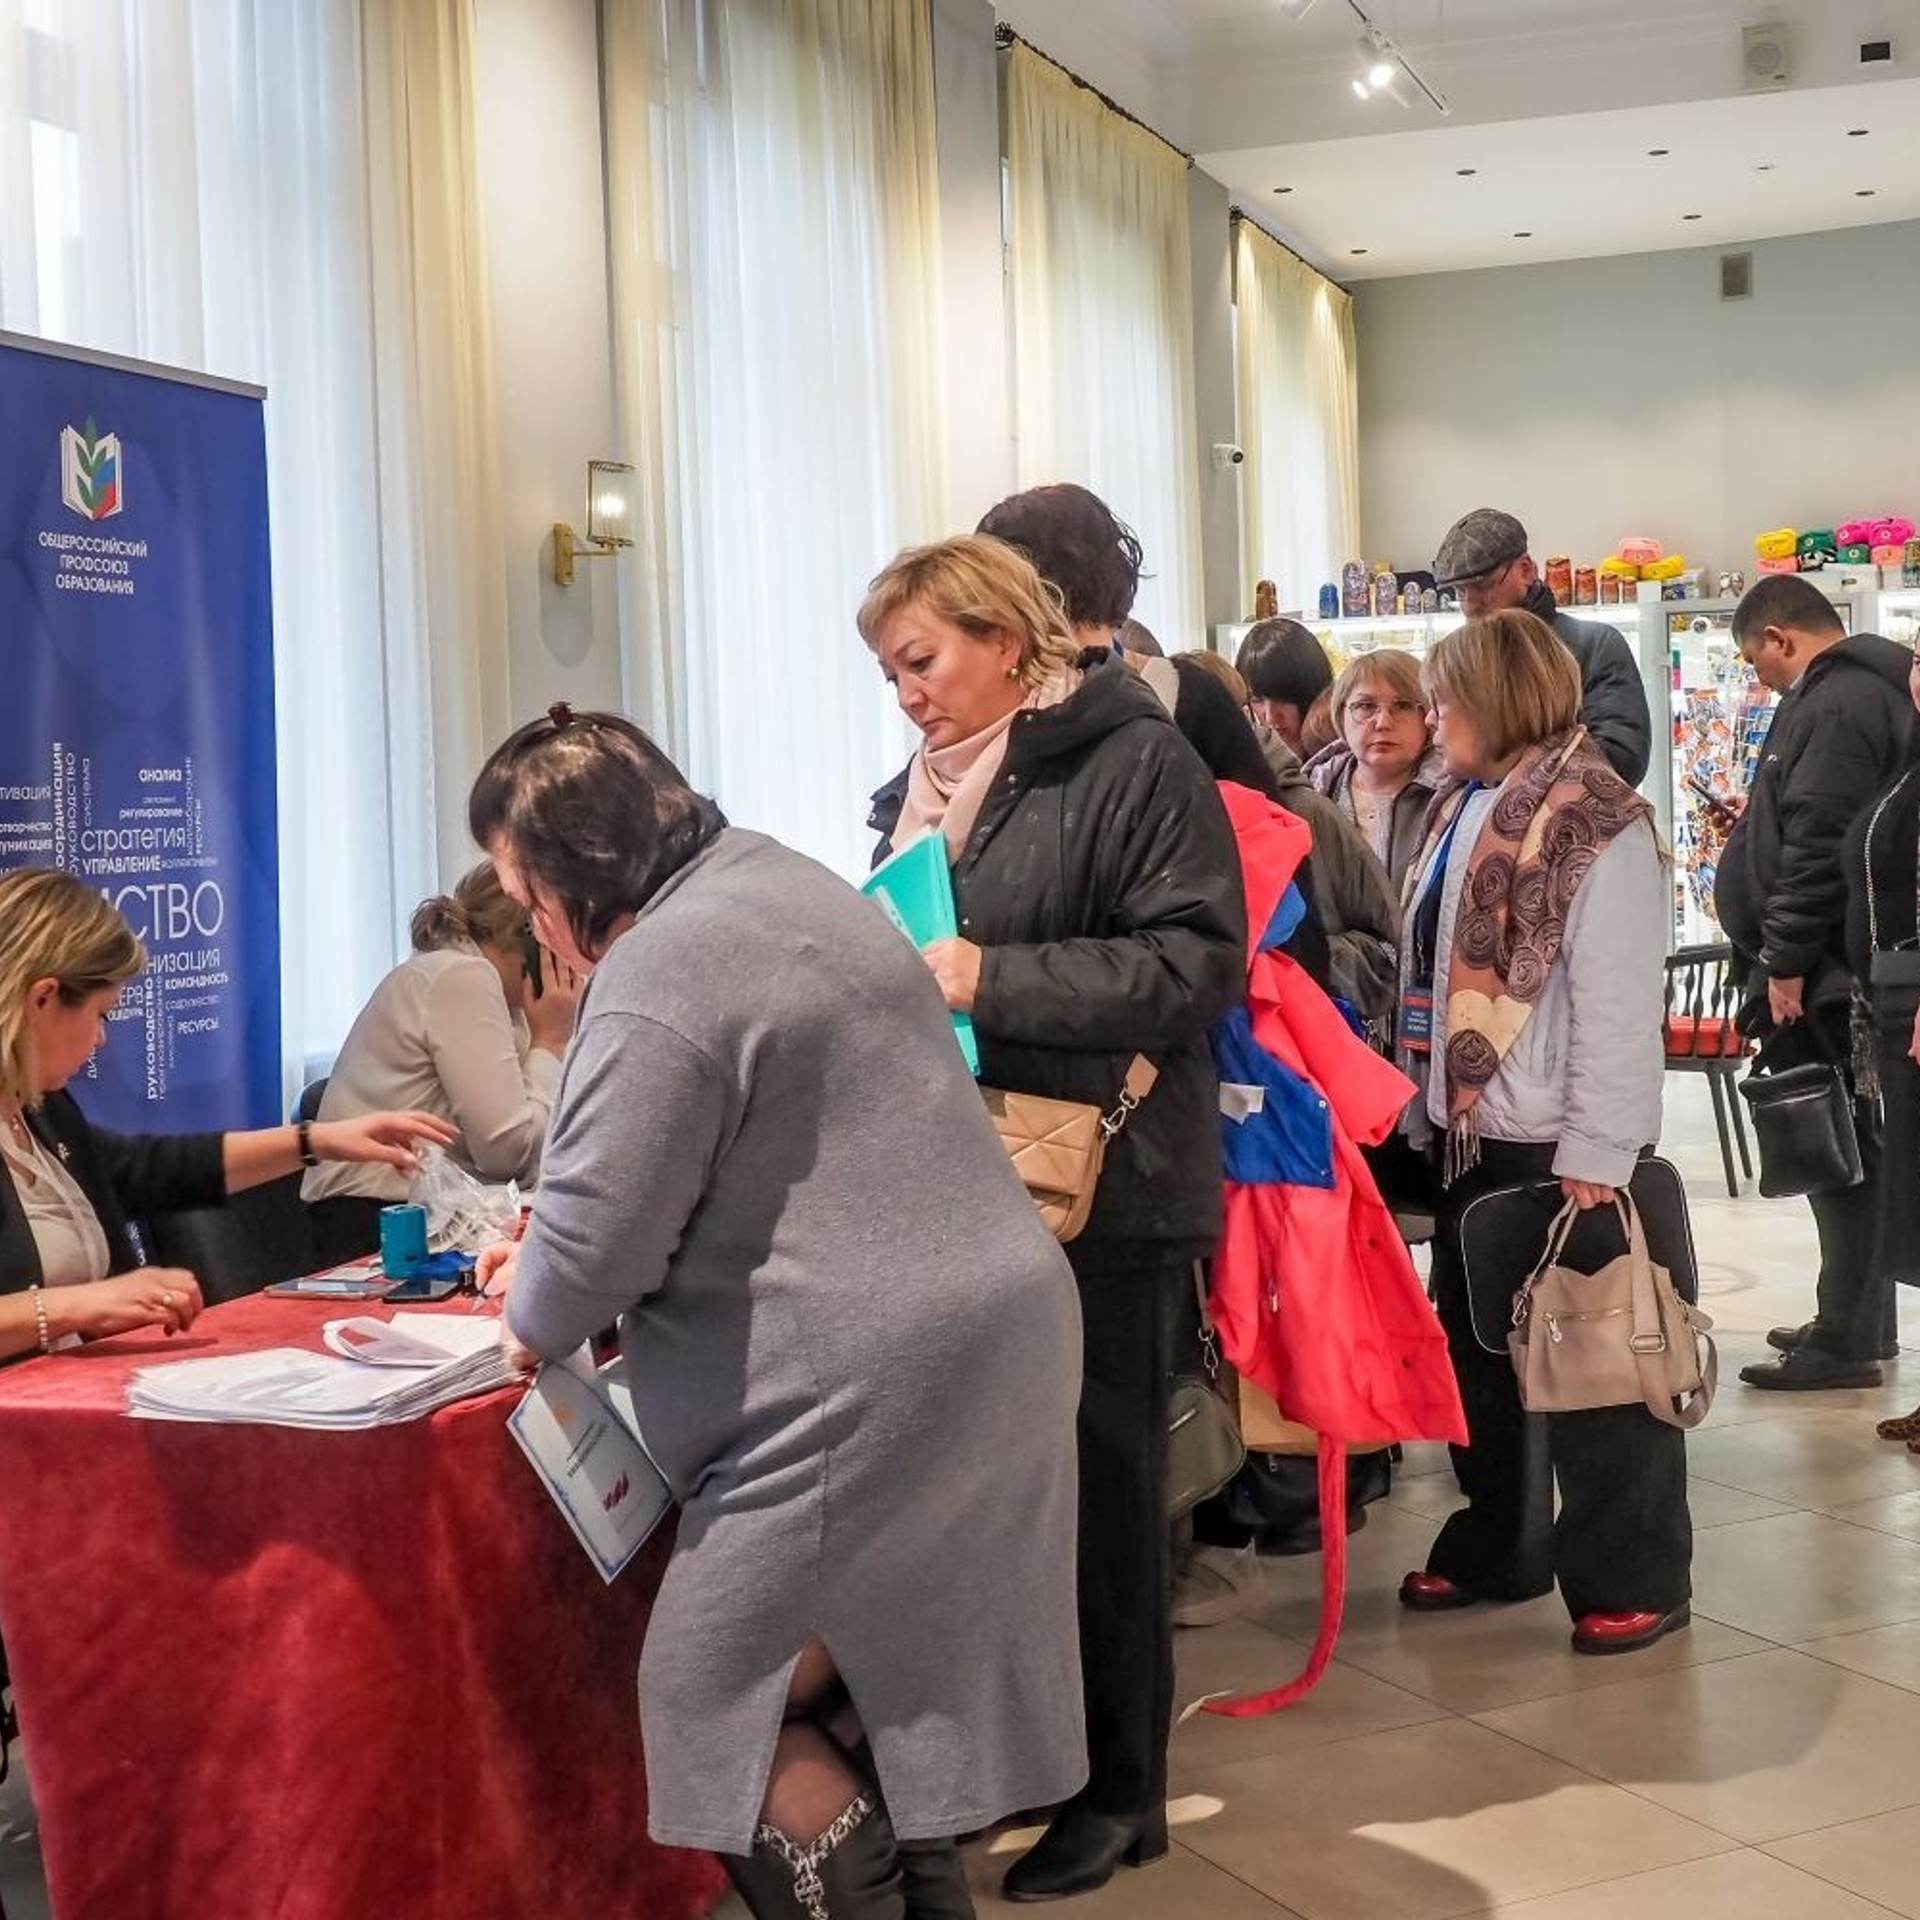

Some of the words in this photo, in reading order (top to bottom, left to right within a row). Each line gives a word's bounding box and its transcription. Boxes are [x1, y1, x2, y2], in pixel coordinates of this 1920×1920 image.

[38, 531, 148, 557] ОБЩЕРОССИЙСКИЙ
[60, 555, 128, 575] ПРОФСОЮЗ
[55, 574, 134, 595] ОБРАЗОВАНИЯ
[138, 769, 182, 782] анализ
[53, 743, 65, 870] оординация
[81, 828, 186, 857] стратегия
[82, 855, 161, 875] УПРАВЛЕНИЕ
[102, 880, 224, 941] СТВО
[145, 948, 220, 975] низация
[144, 977, 158, 1099] руководство
